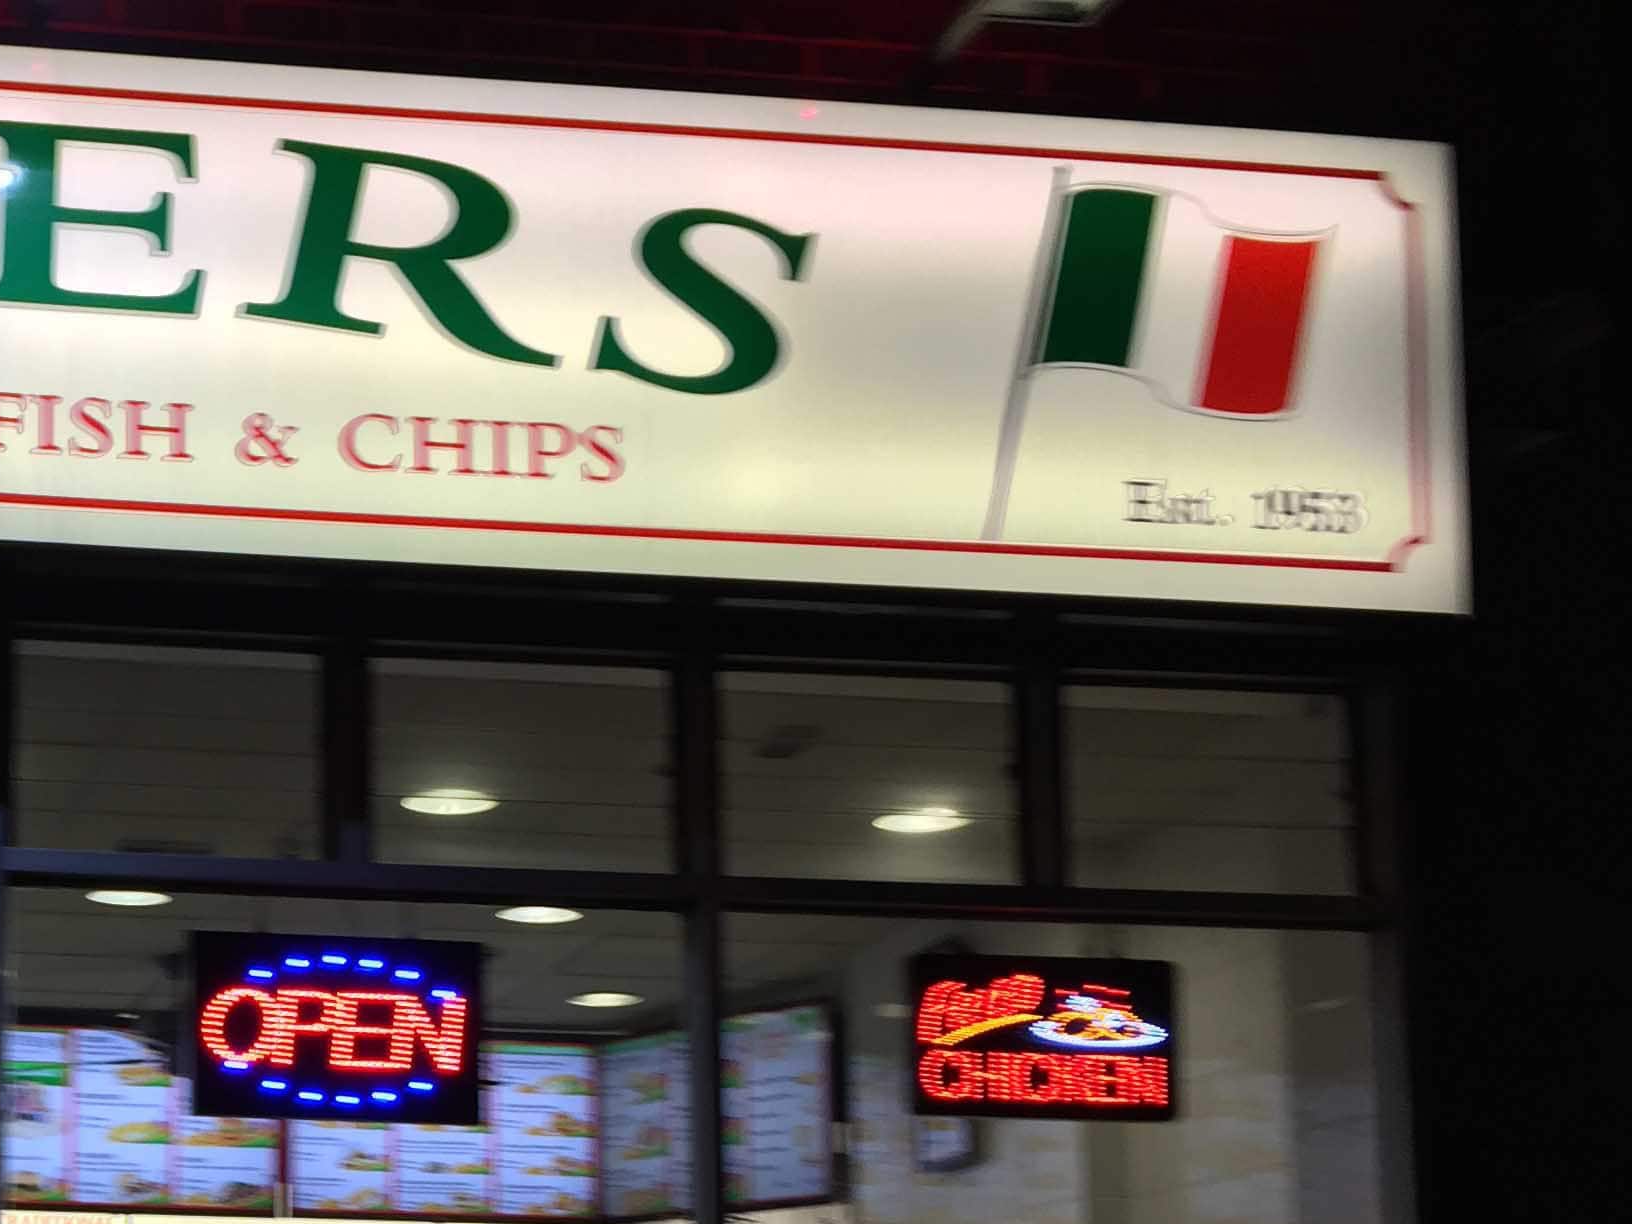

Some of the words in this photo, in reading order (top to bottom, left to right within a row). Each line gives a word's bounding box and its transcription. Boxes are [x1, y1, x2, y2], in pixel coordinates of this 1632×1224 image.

[234, 411, 299, 467] &
[338, 412, 626, 483] CHIPS
[1121, 479, 1234, 526] Est.
[199, 987, 468, 1073] OPEN
[918, 1048, 1170, 1105] CHICKEN
